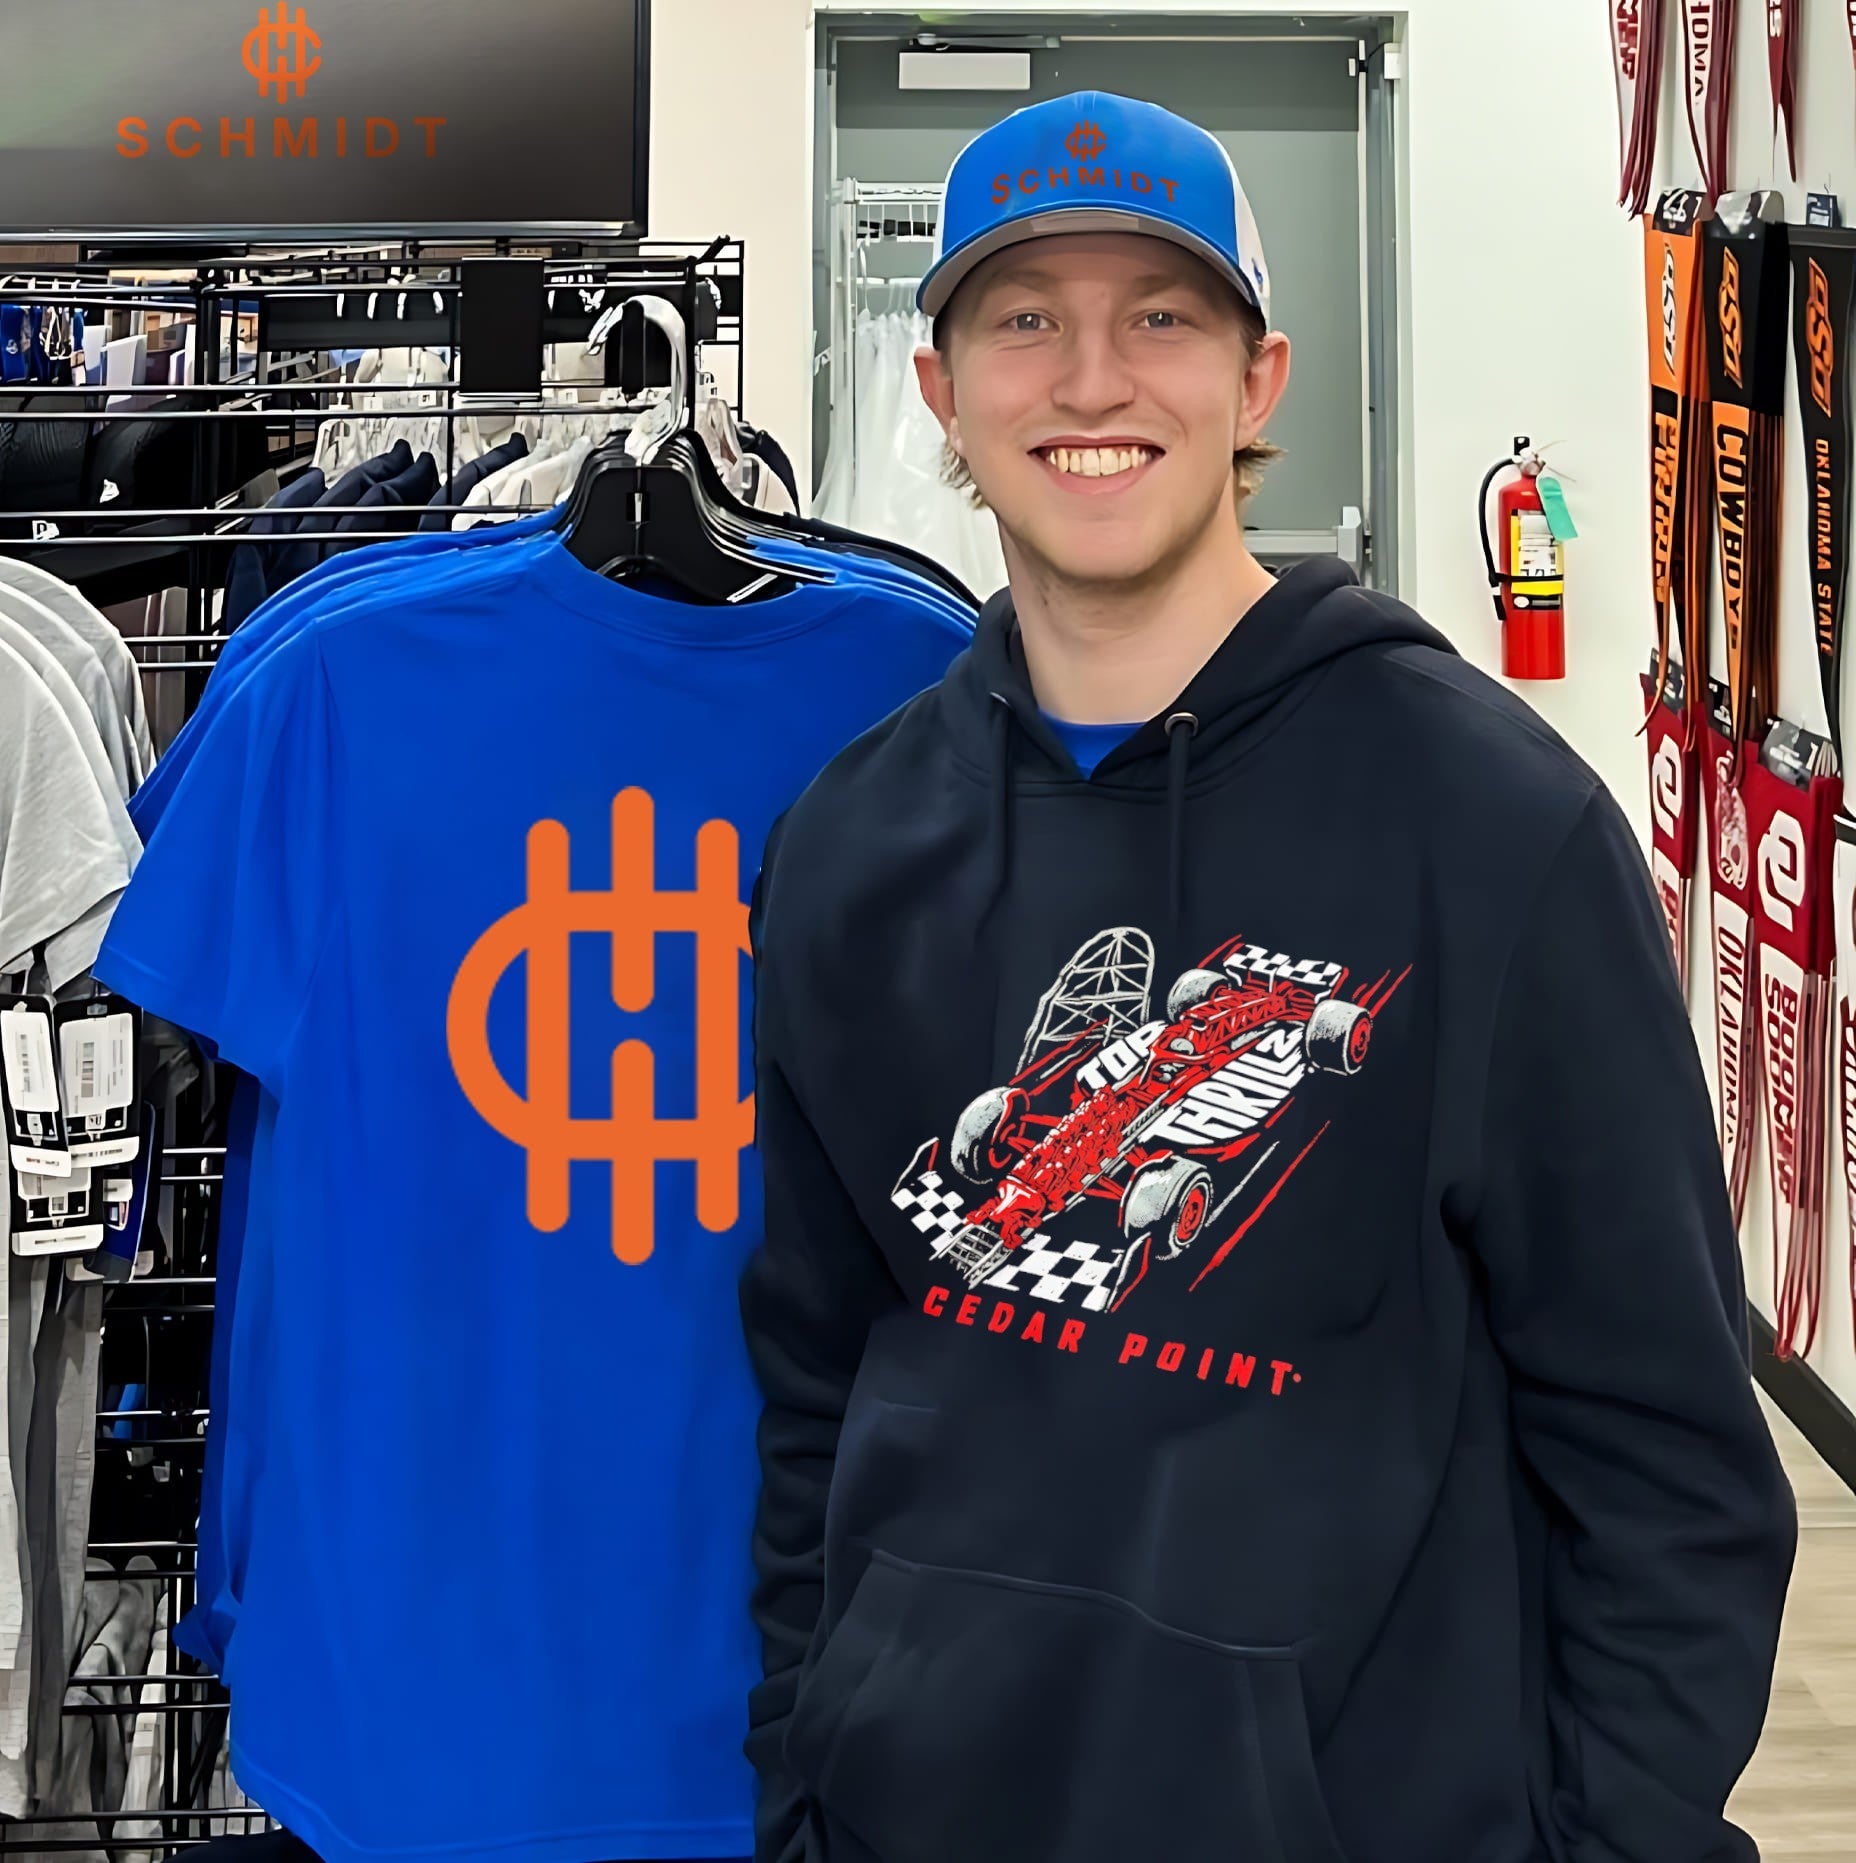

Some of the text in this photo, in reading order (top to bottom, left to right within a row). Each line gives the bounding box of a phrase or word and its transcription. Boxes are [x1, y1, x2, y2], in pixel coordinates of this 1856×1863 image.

[116, 117, 447, 158] SCHMIDT
[991, 167, 1179, 204] SCHMIDT
[1815, 438, 1832, 570] OKLAHOMA
[1077, 1020, 1168, 1089] TOP
[1717, 926, 1745, 1143] OKLAHOMA
[923, 1285, 1295, 1396] CEDAR POINT
